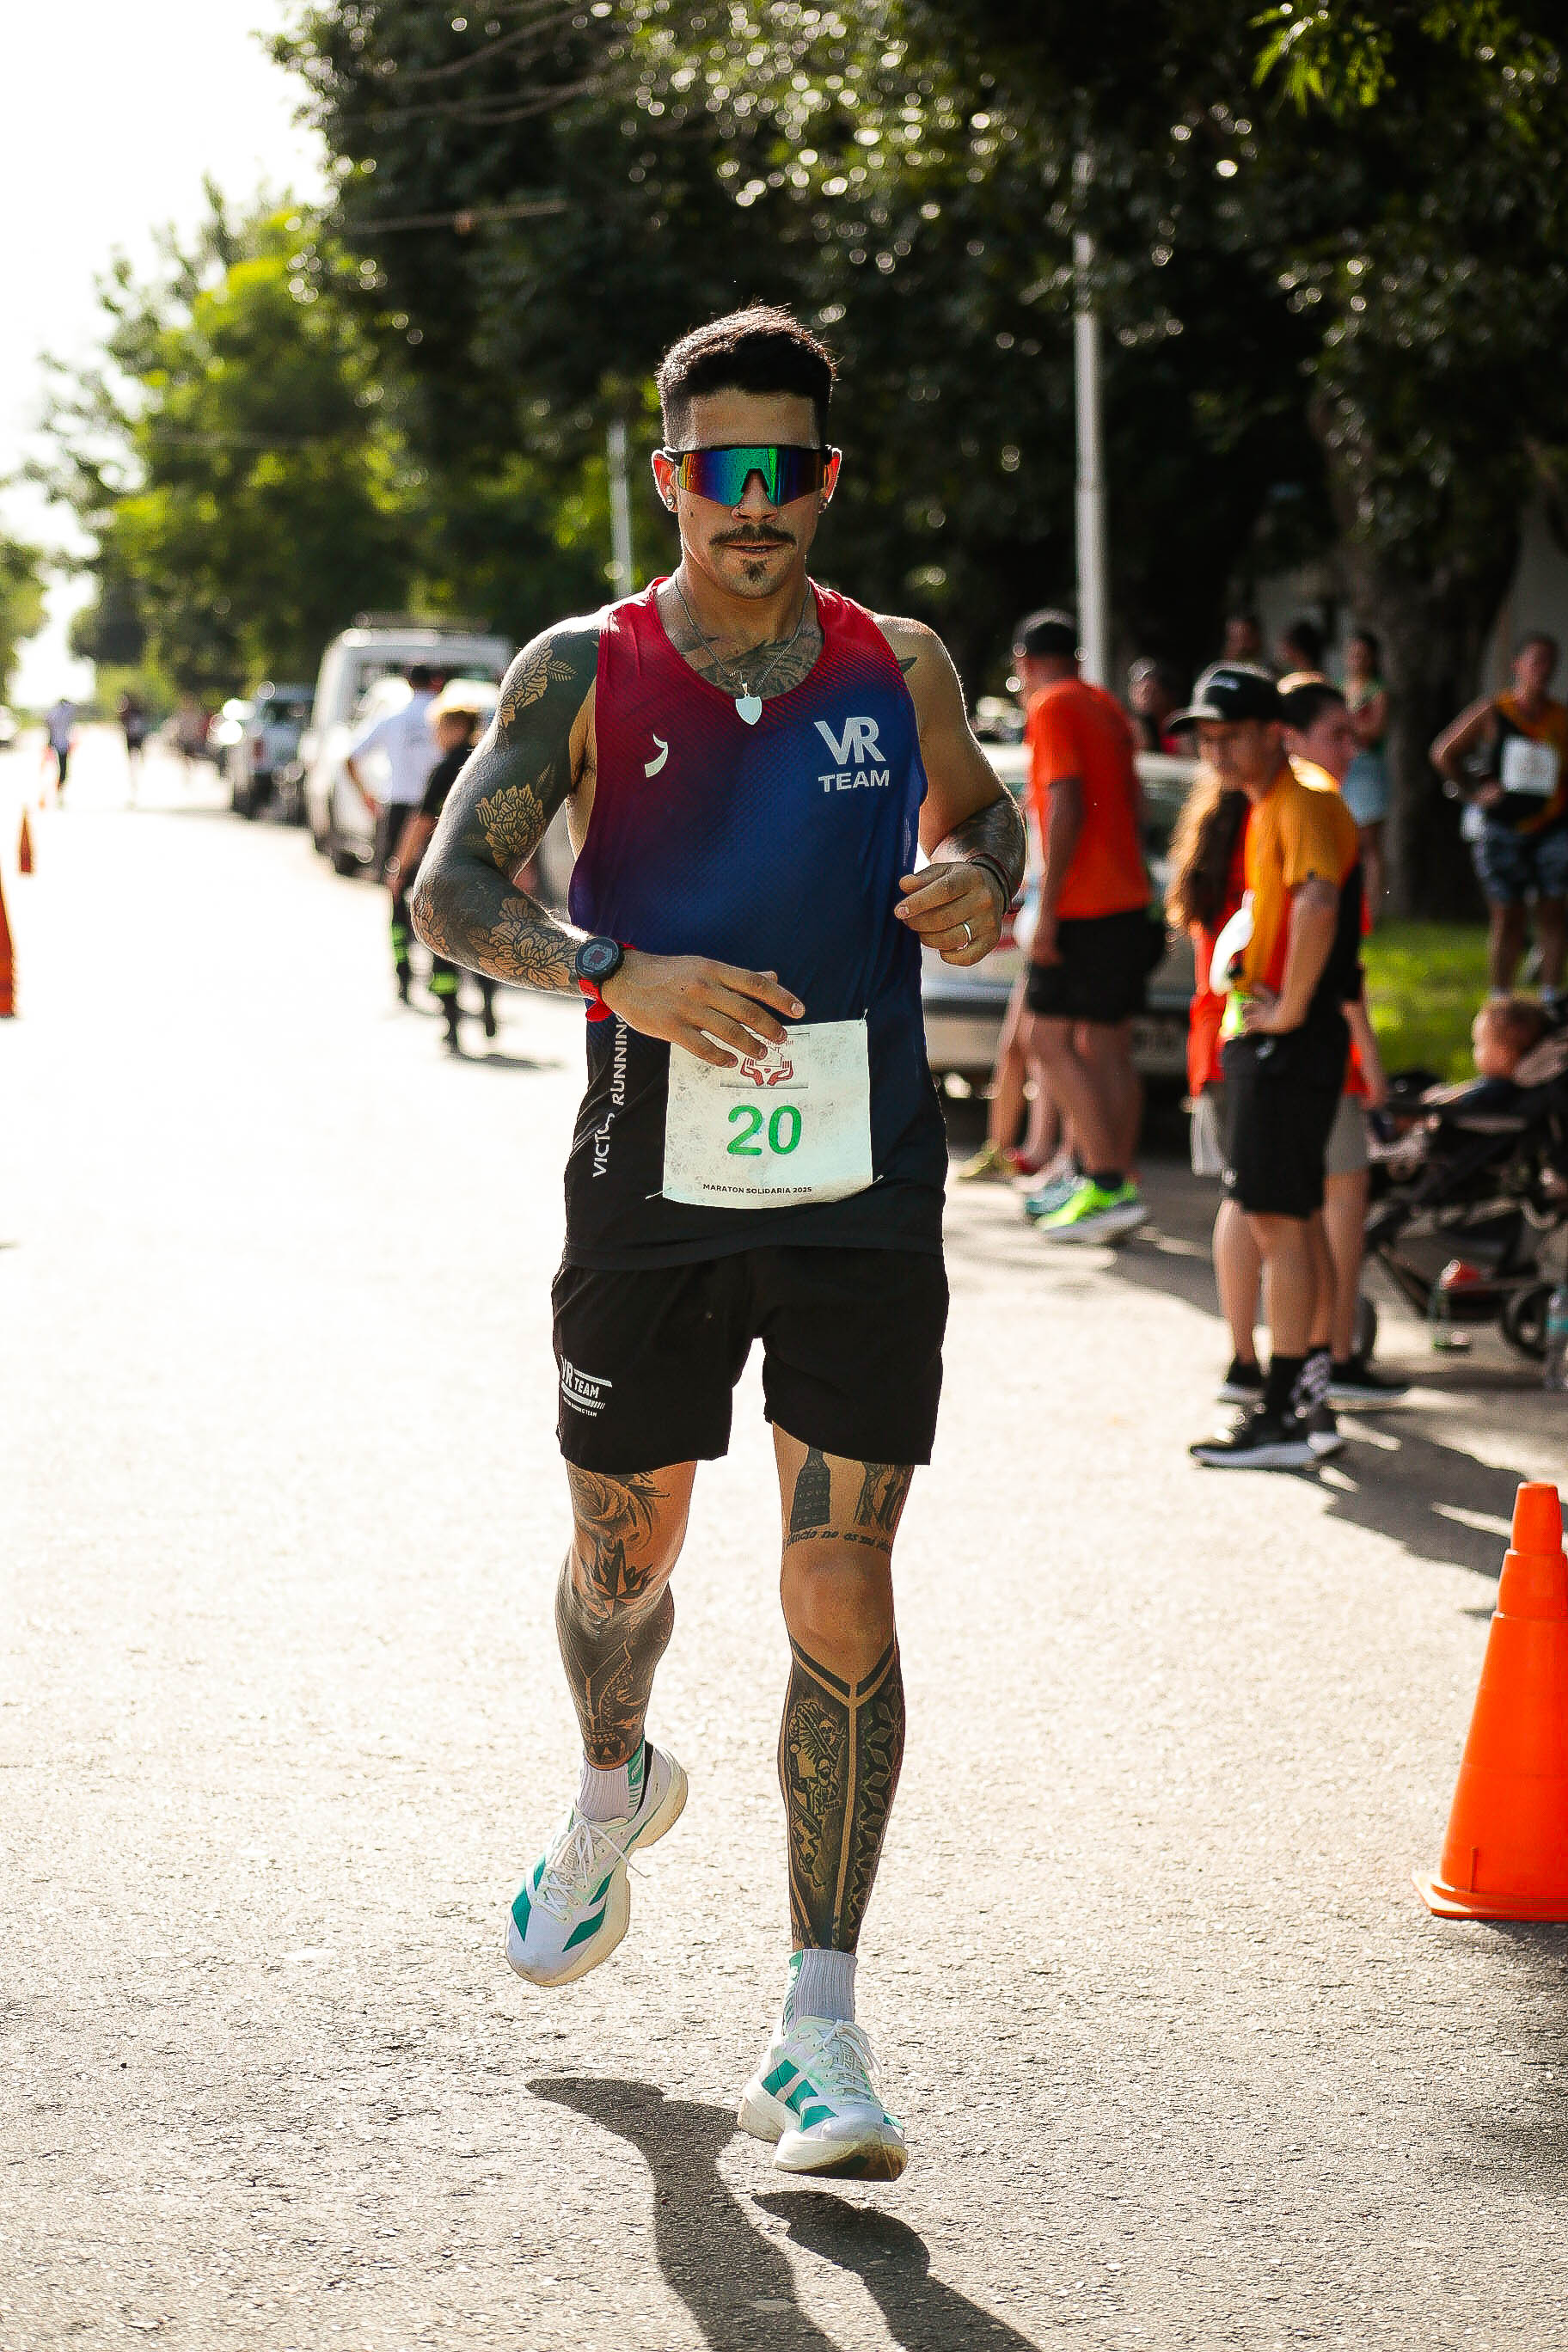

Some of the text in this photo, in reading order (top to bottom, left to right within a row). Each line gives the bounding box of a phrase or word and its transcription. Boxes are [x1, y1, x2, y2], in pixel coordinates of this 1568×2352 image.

[813, 716, 886, 765] VR
[818, 770, 890, 793] TEAM
[726, 1104, 802, 1155] 20
[702, 1184, 744, 1194] MARATON
[574, 1377, 600, 1399] TEAM
